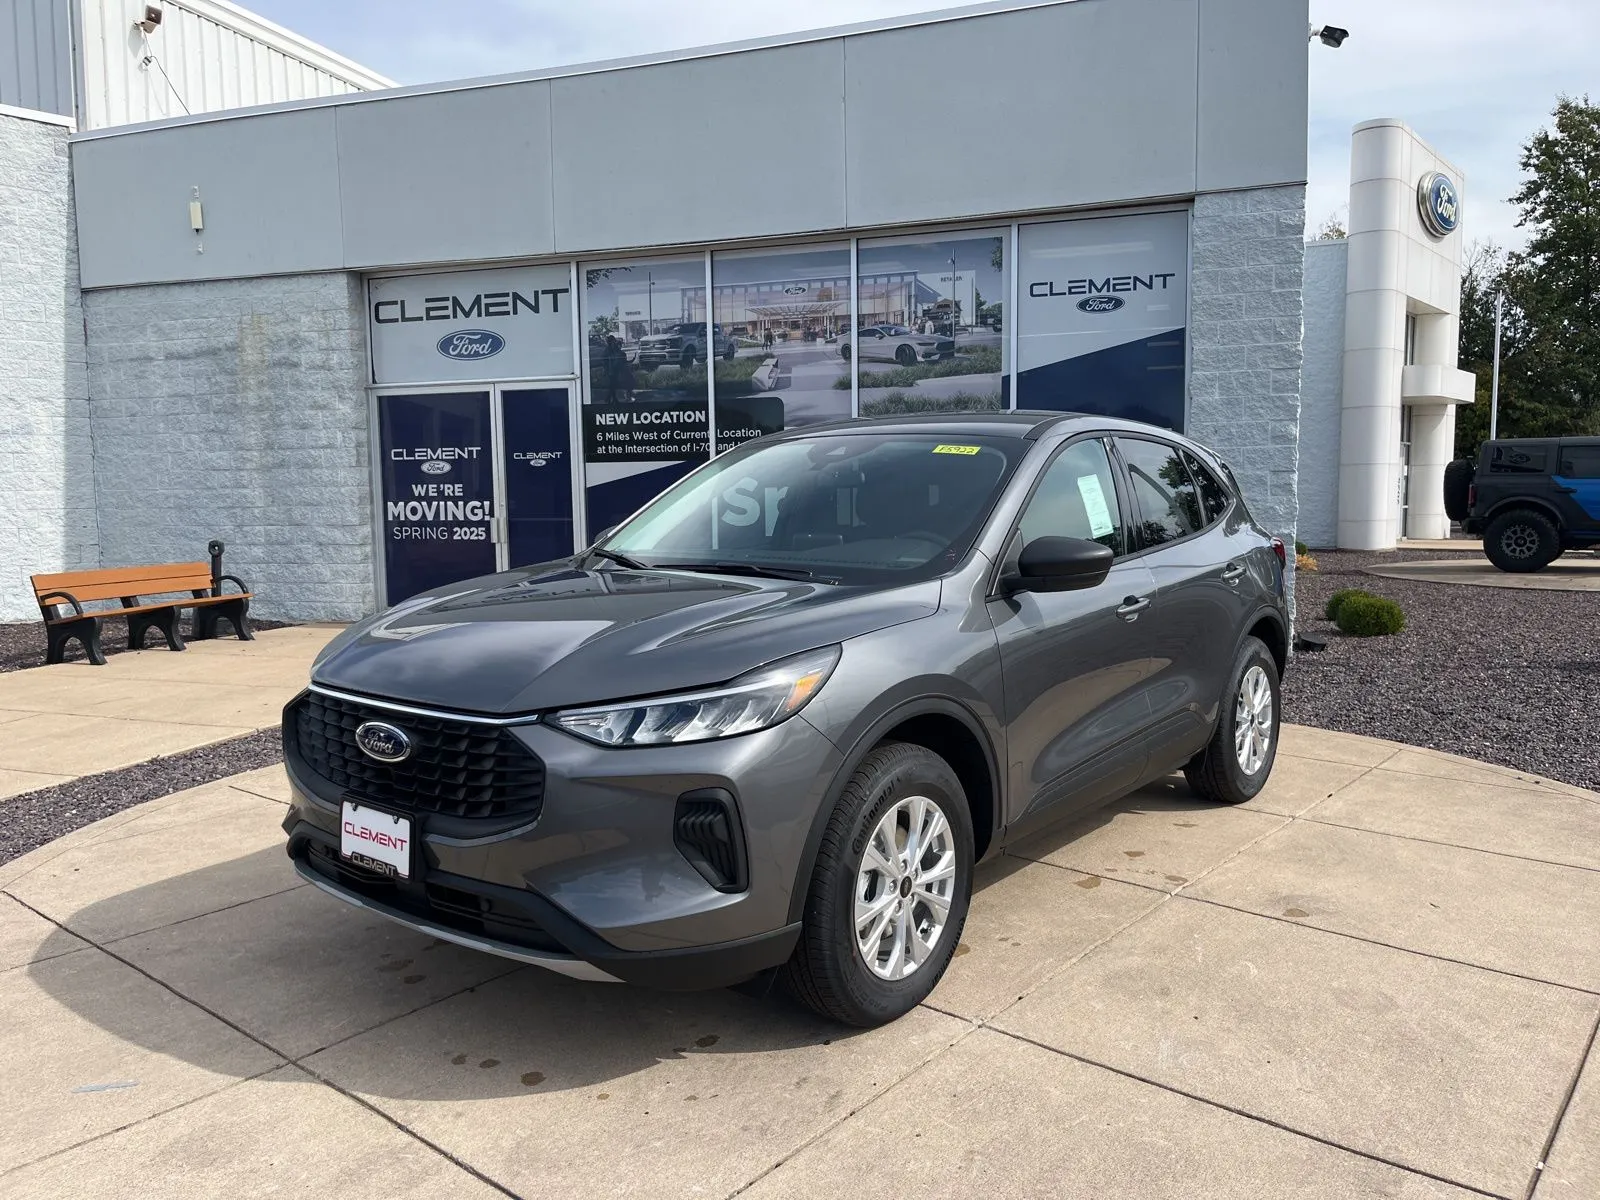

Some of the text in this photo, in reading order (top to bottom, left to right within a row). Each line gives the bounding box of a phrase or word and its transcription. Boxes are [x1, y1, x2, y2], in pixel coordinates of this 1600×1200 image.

[1437, 184, 1457, 222] Ford
[1029, 273, 1176, 298] CLEMENT
[374, 288, 570, 324] CLEMENT
[595, 410, 706, 426] NEW LOCATION
[596, 432, 603, 441] 6
[605, 431, 630, 441] Miles
[632, 431, 658, 440] West
[660, 430, 671, 440] of
[717, 428, 762, 438] Location
[391, 447, 481, 460] CLEMENT
[513, 451, 563, 460] CLEMENT
[597, 445, 606, 454] at
[608, 444, 623, 454] the
[625, 443, 679, 454] Intersection
[681, 442, 691, 452] of
[693, 442, 711, 452] I-70
[717, 441, 735, 451] and
[411, 483, 464, 497] WE'RE
[387, 500, 491, 521] MOVING!
[393, 526, 486, 540] SPRING 2025
[851, 780, 897, 855] Continental
[344, 821, 407, 852] CLEMENT
[352, 853, 396, 877] CLEMENT
